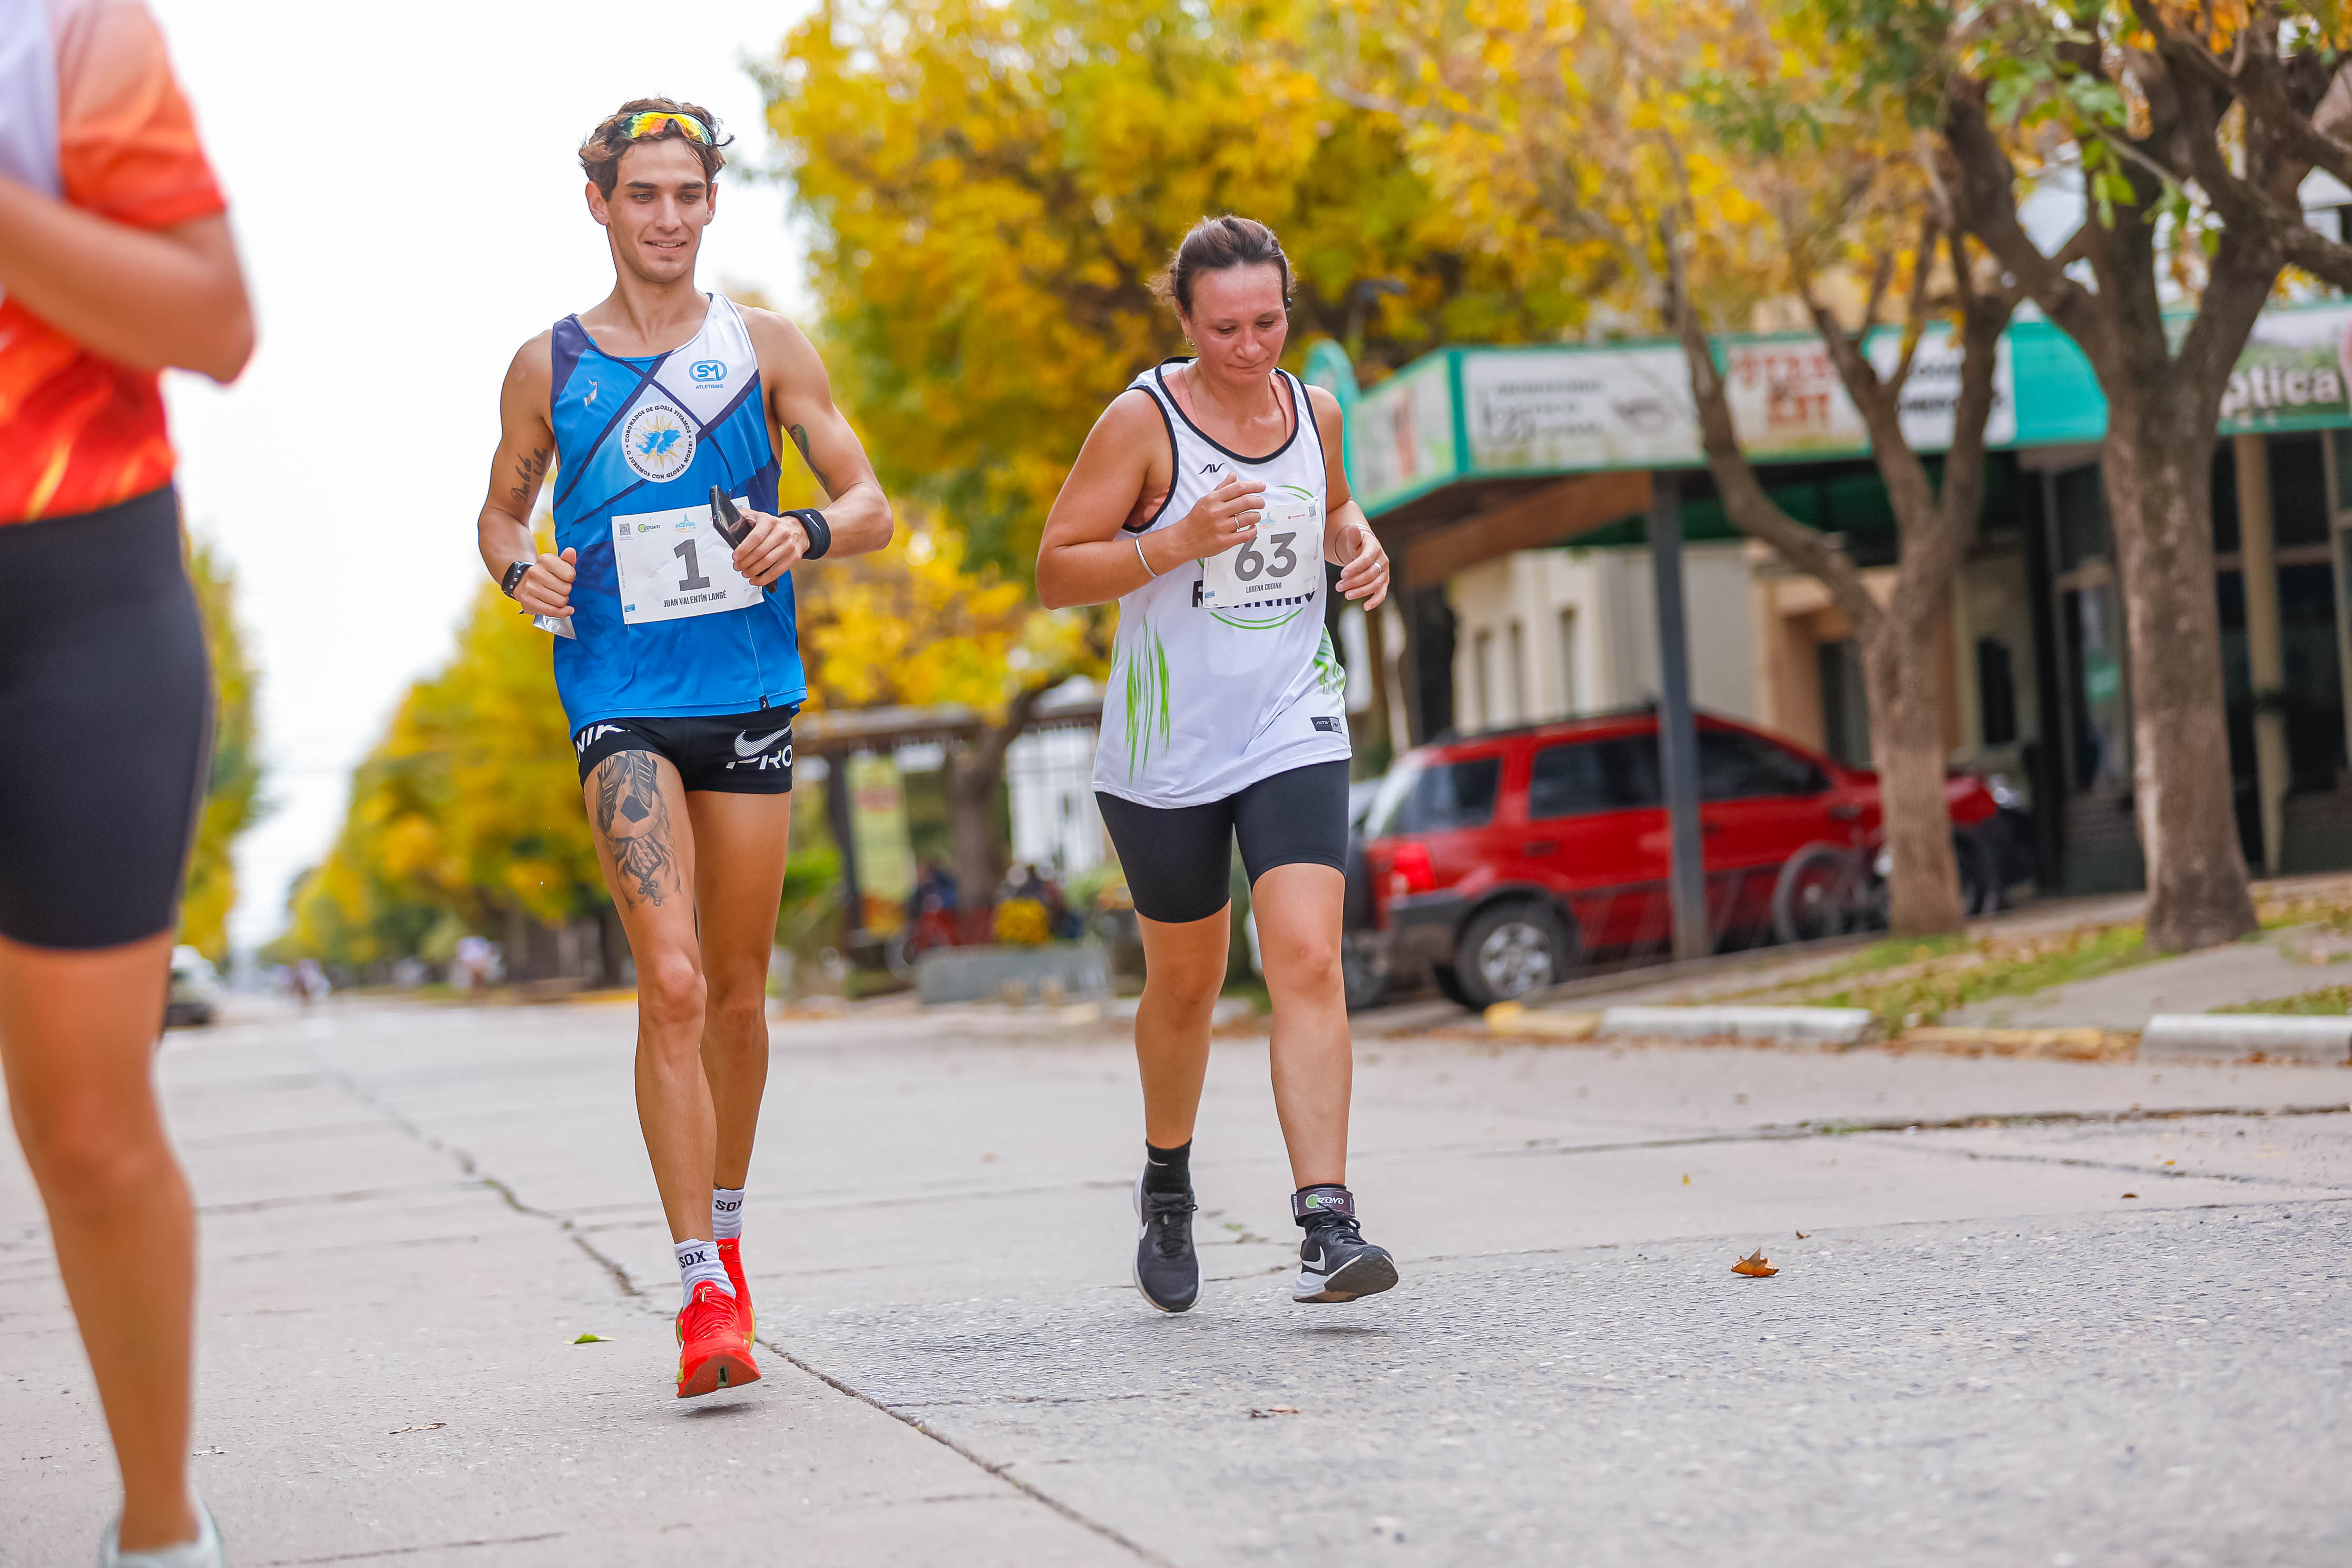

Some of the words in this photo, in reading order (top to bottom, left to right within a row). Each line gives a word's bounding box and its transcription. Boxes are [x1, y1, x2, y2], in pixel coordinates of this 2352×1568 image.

[2219, 361, 2341, 418] ptica
[625, 410, 645, 443] CORONADOS
[674, 409, 691, 434] VIVAMOS
[629, 456, 650, 476] JUREMOS
[666, 464, 685, 478] GLORIA
[674, 539, 710, 591] 1
[1235, 532, 1297, 581] 63
[664, 599, 678, 607] JUAN
[679, 593, 707, 605] VALENTÍN
[708, 590, 727, 601] LANGÉ
[1246, 584, 1263, 593] LORENA
[1265, 582, 1282, 591] CODINA
[577, 724, 632, 762] NIK
[679, 1250, 707, 1268] SOX
